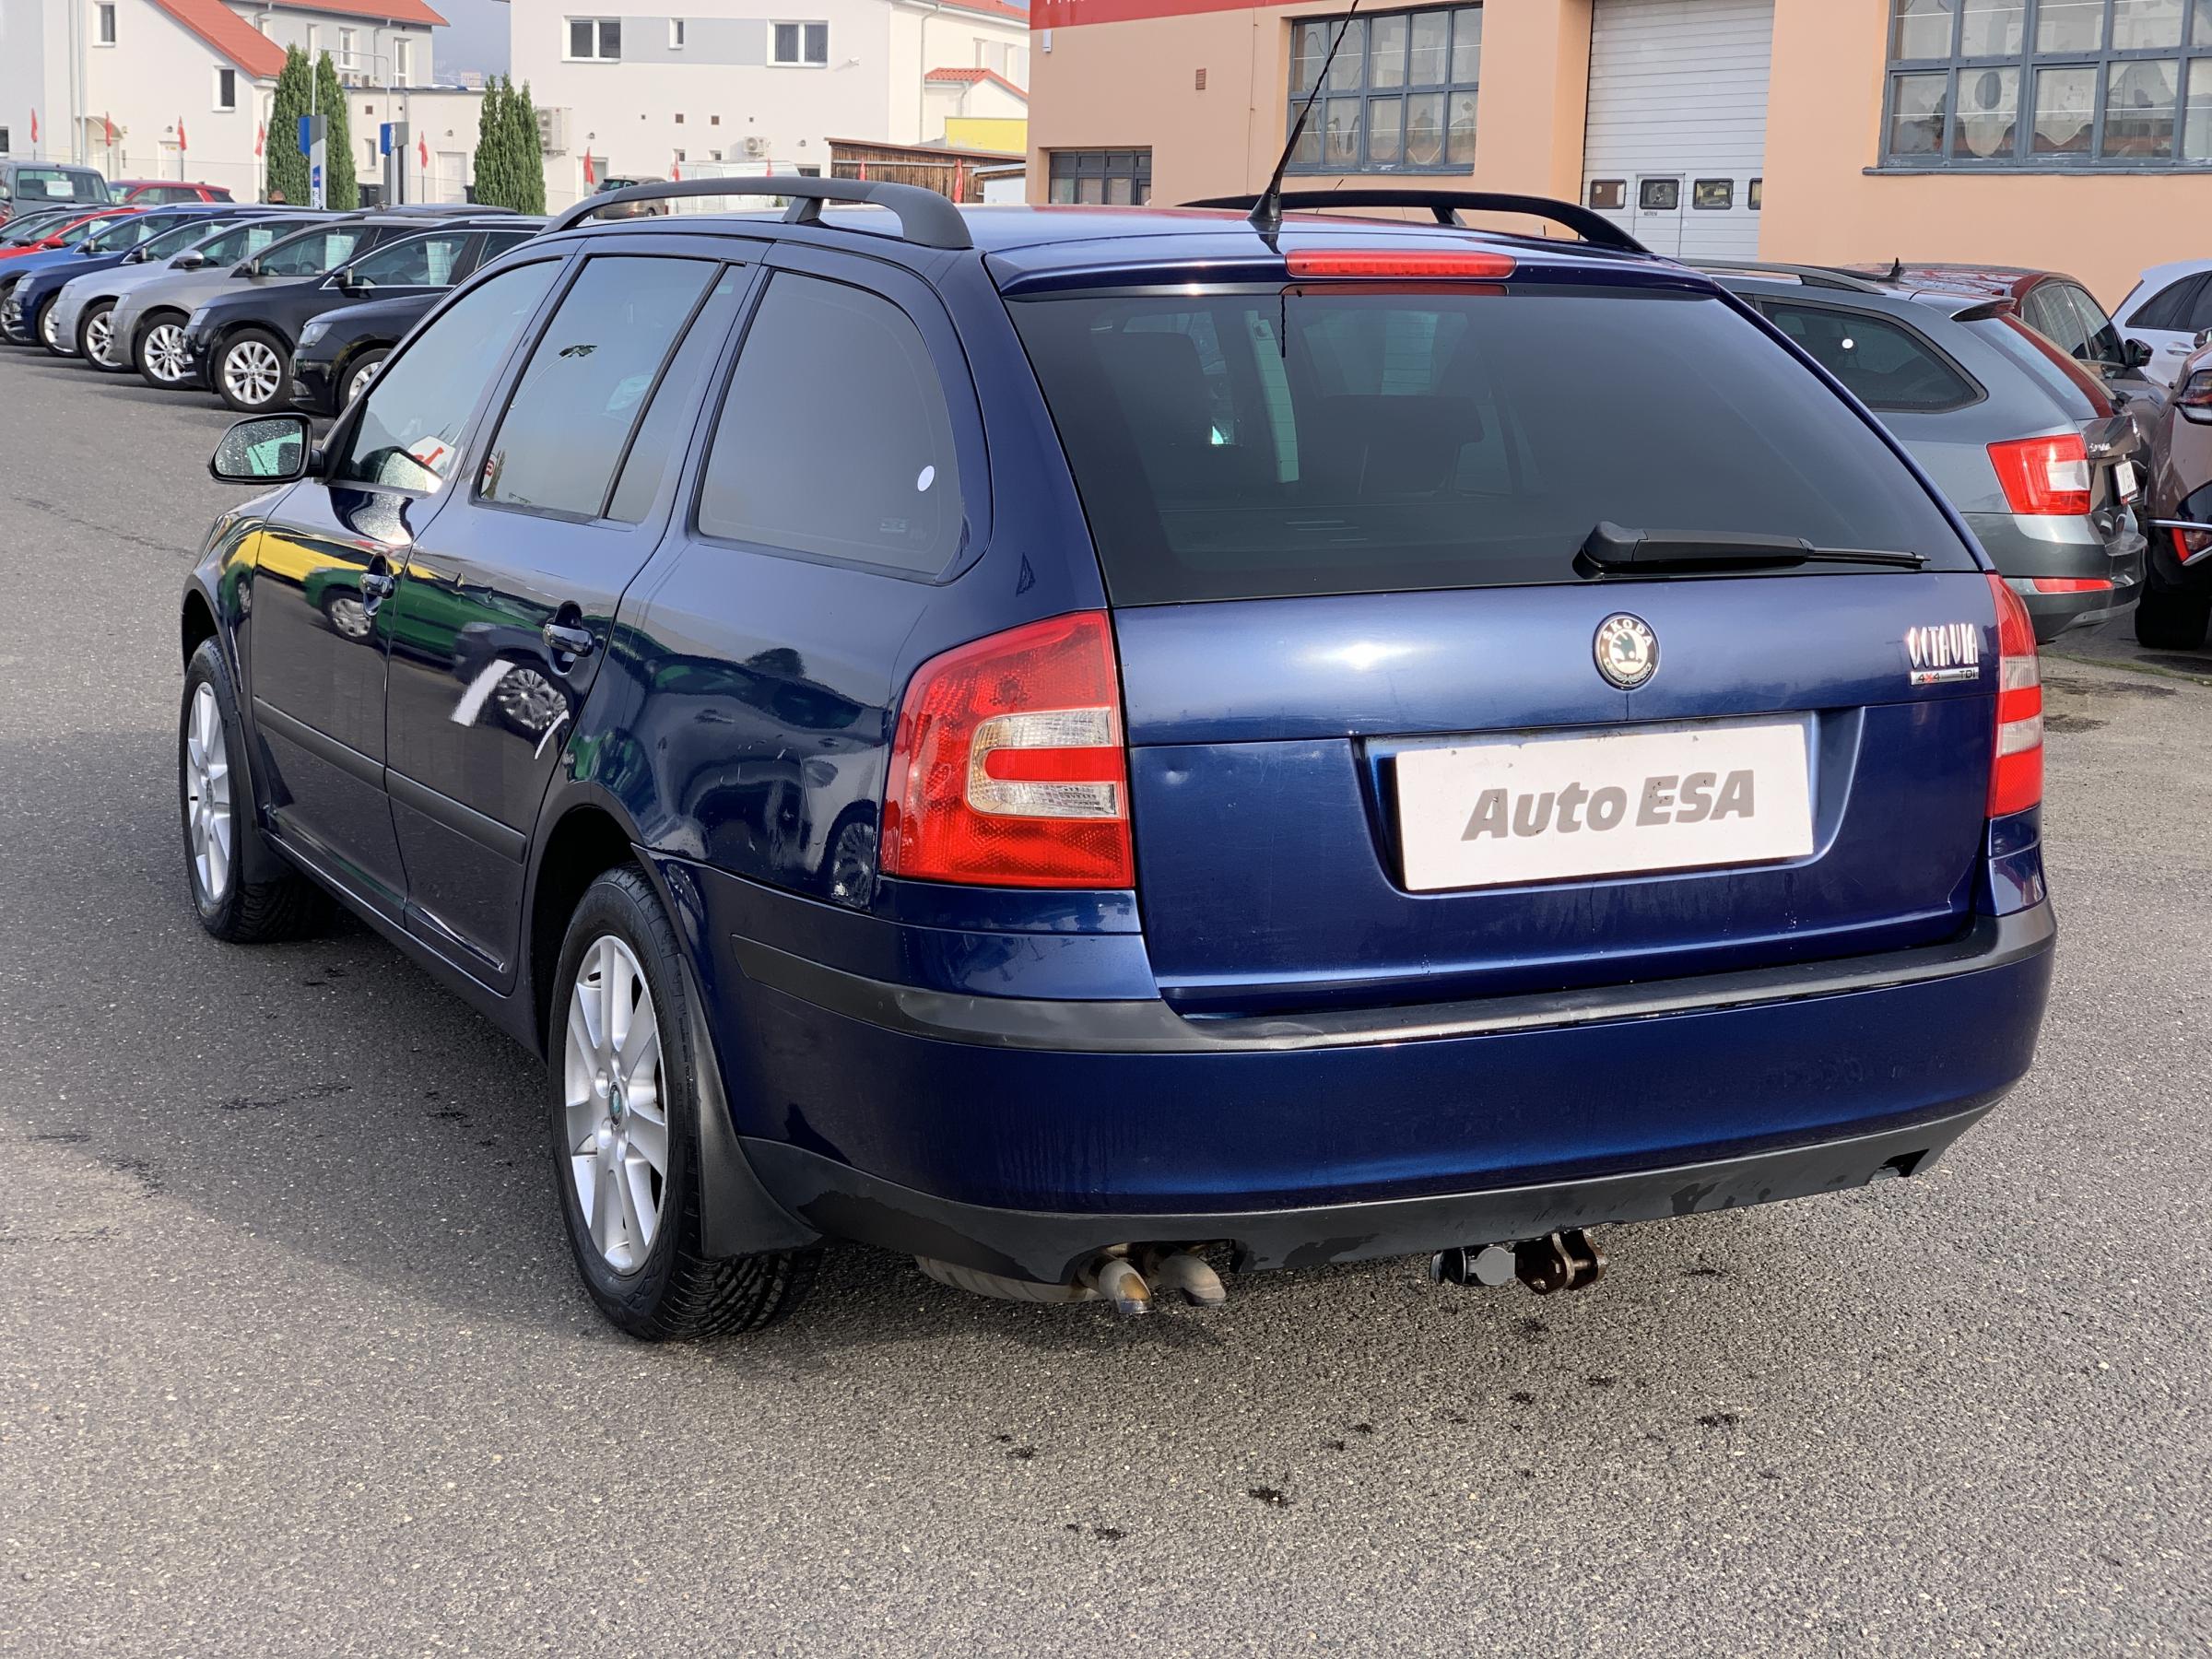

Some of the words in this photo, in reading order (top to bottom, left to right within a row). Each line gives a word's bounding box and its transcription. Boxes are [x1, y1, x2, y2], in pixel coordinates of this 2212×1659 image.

[1909, 623, 1979, 668] OCTAVIA
[1959, 668, 1976, 679] TDI
[1461, 782, 1628, 841] Auto
[1635, 769, 1755, 827] ESA
